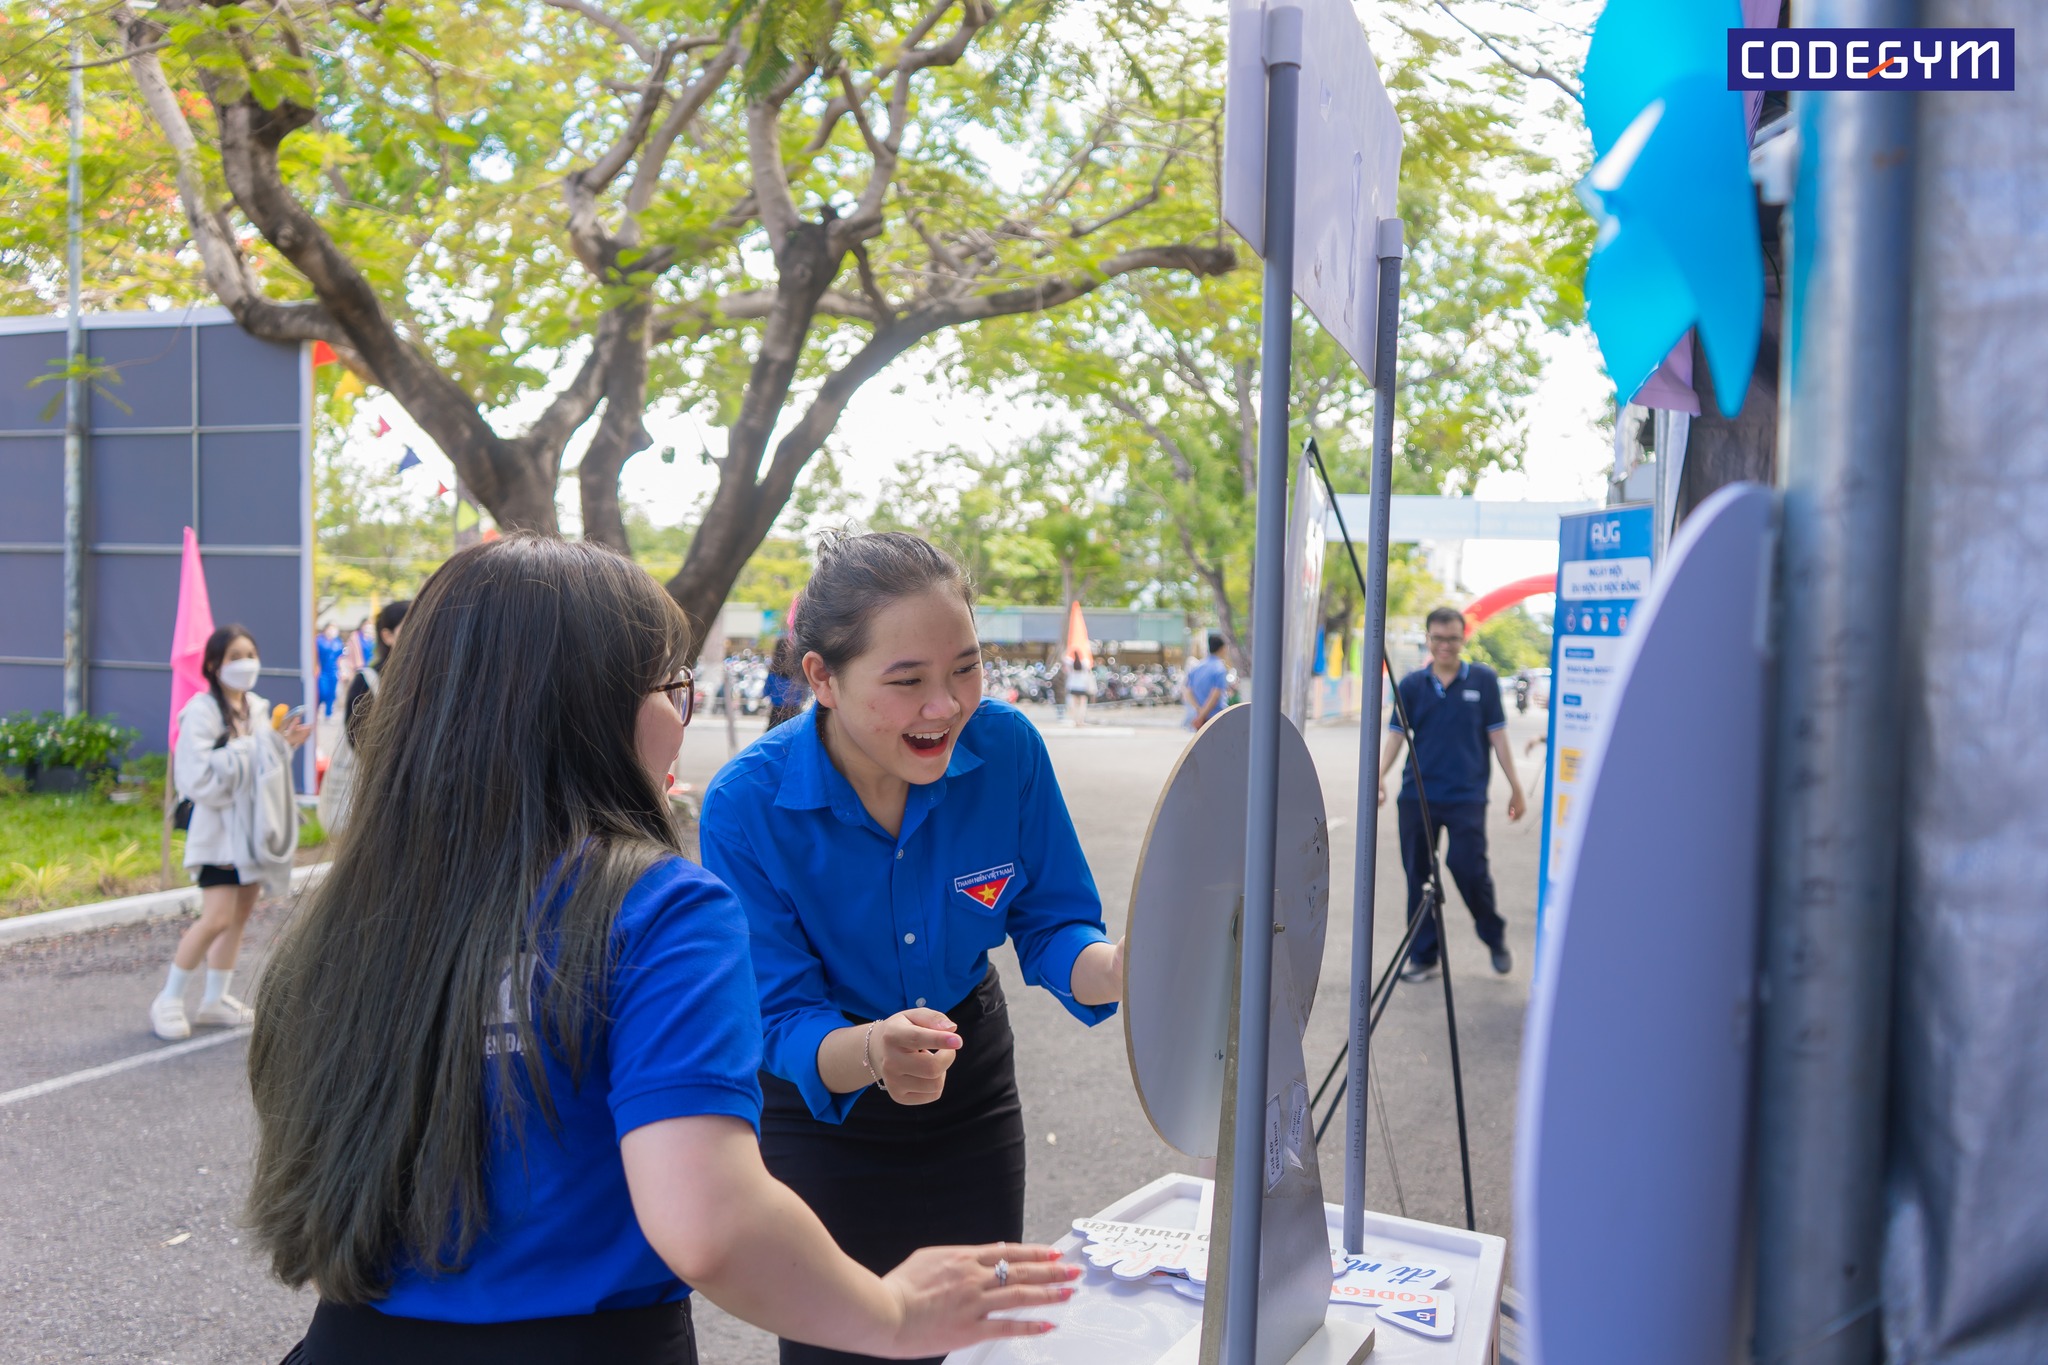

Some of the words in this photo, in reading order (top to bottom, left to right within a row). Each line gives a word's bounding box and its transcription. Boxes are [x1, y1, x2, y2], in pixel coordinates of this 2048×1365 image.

[957, 879, 974, 888] THANH
[974, 874, 988, 884] NIÊN
[999, 867, 1013, 876] NAM
[1081, 1220, 1129, 1235] viên
